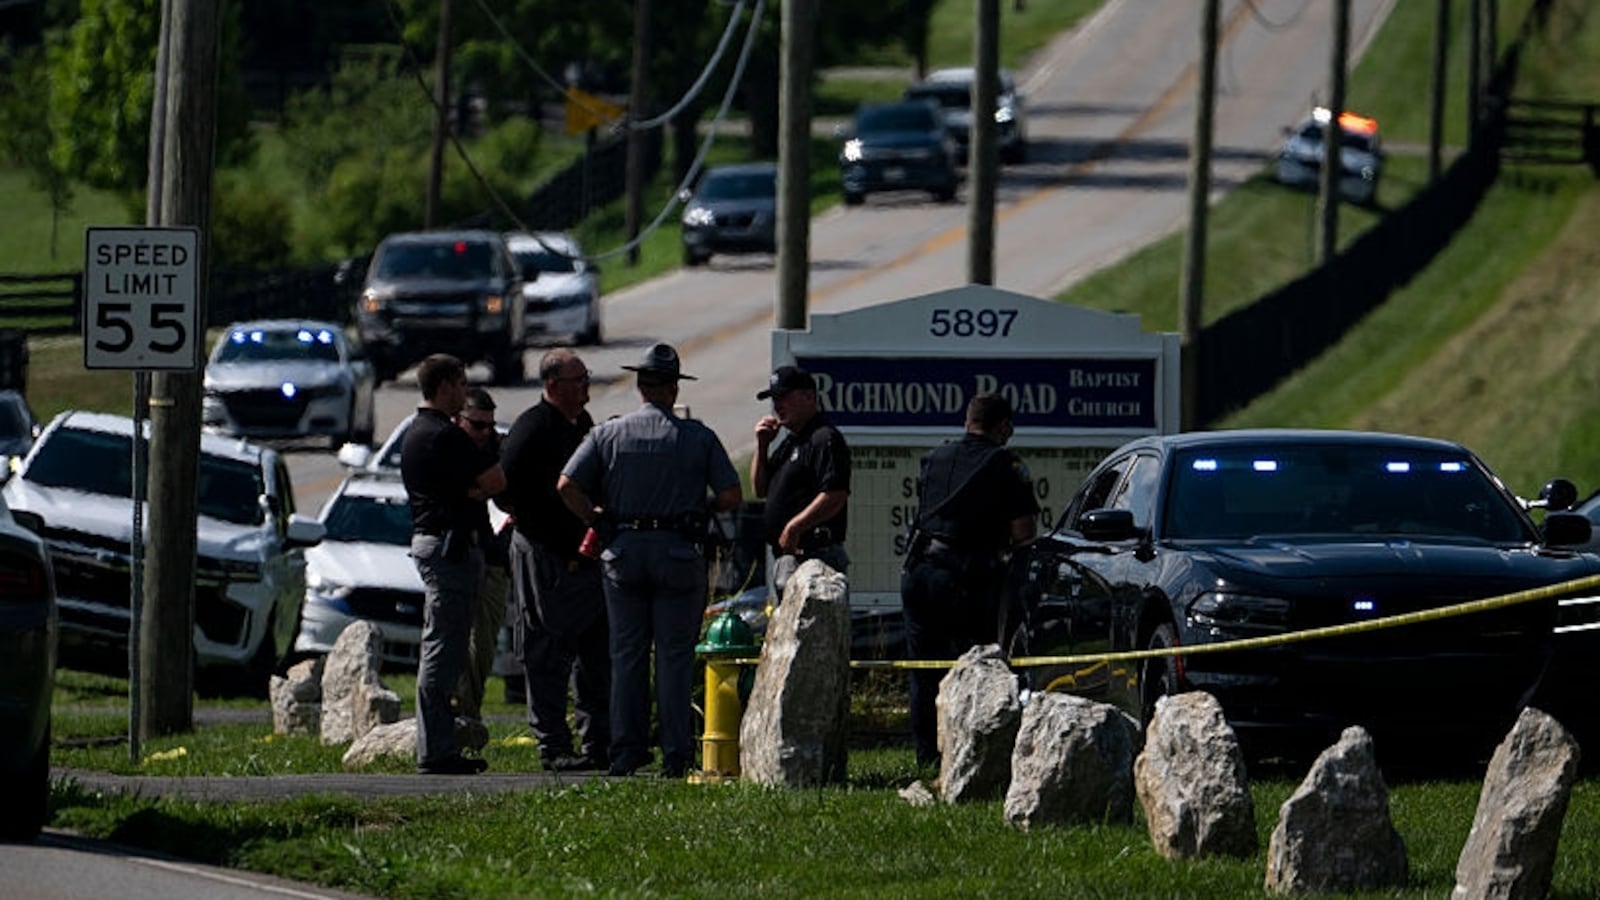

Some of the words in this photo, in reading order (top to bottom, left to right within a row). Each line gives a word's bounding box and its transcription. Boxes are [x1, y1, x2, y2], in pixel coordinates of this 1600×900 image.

[97, 244, 188, 266] SPEED
[105, 273, 177, 295] LIMIT
[95, 302, 186, 354] 55
[930, 308, 1018, 337] 5897
[1069, 368, 1141, 388] BAPTIST
[811, 372, 964, 414] RICHMOND
[1067, 397, 1141, 417] CHURCH
